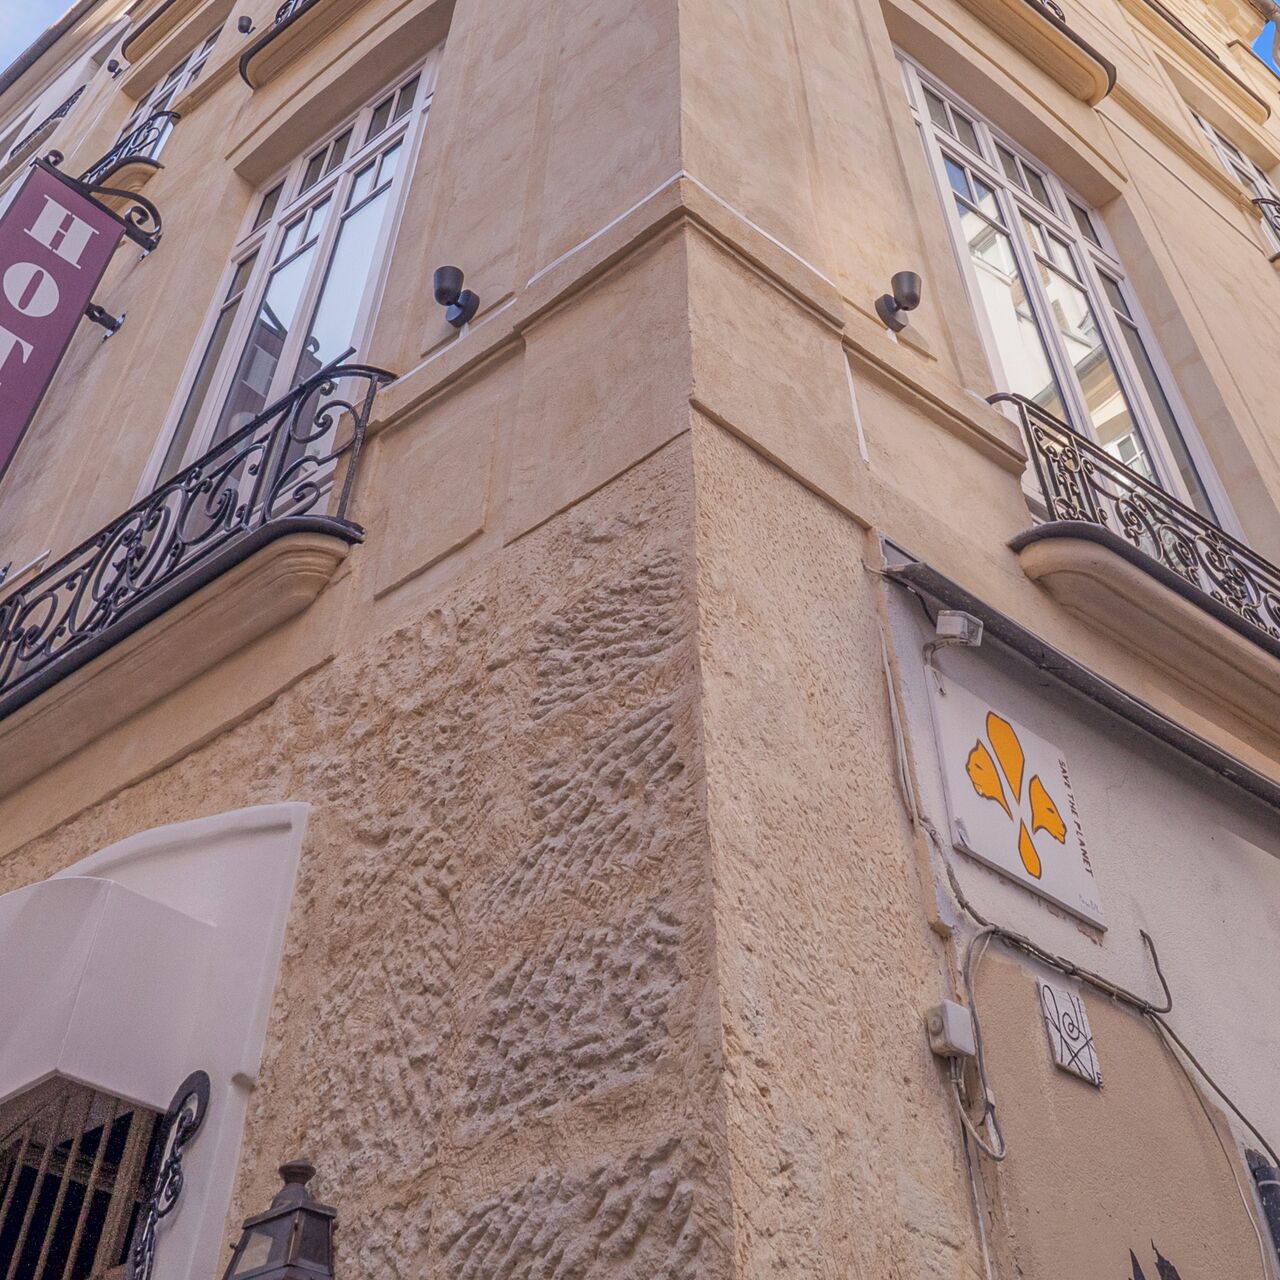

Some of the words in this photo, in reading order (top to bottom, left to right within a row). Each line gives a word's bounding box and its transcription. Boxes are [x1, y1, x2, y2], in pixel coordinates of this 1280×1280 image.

[1058, 759, 1071, 789] SAVE
[1067, 793, 1078, 817] THE
[1074, 820, 1094, 878] PLANET
